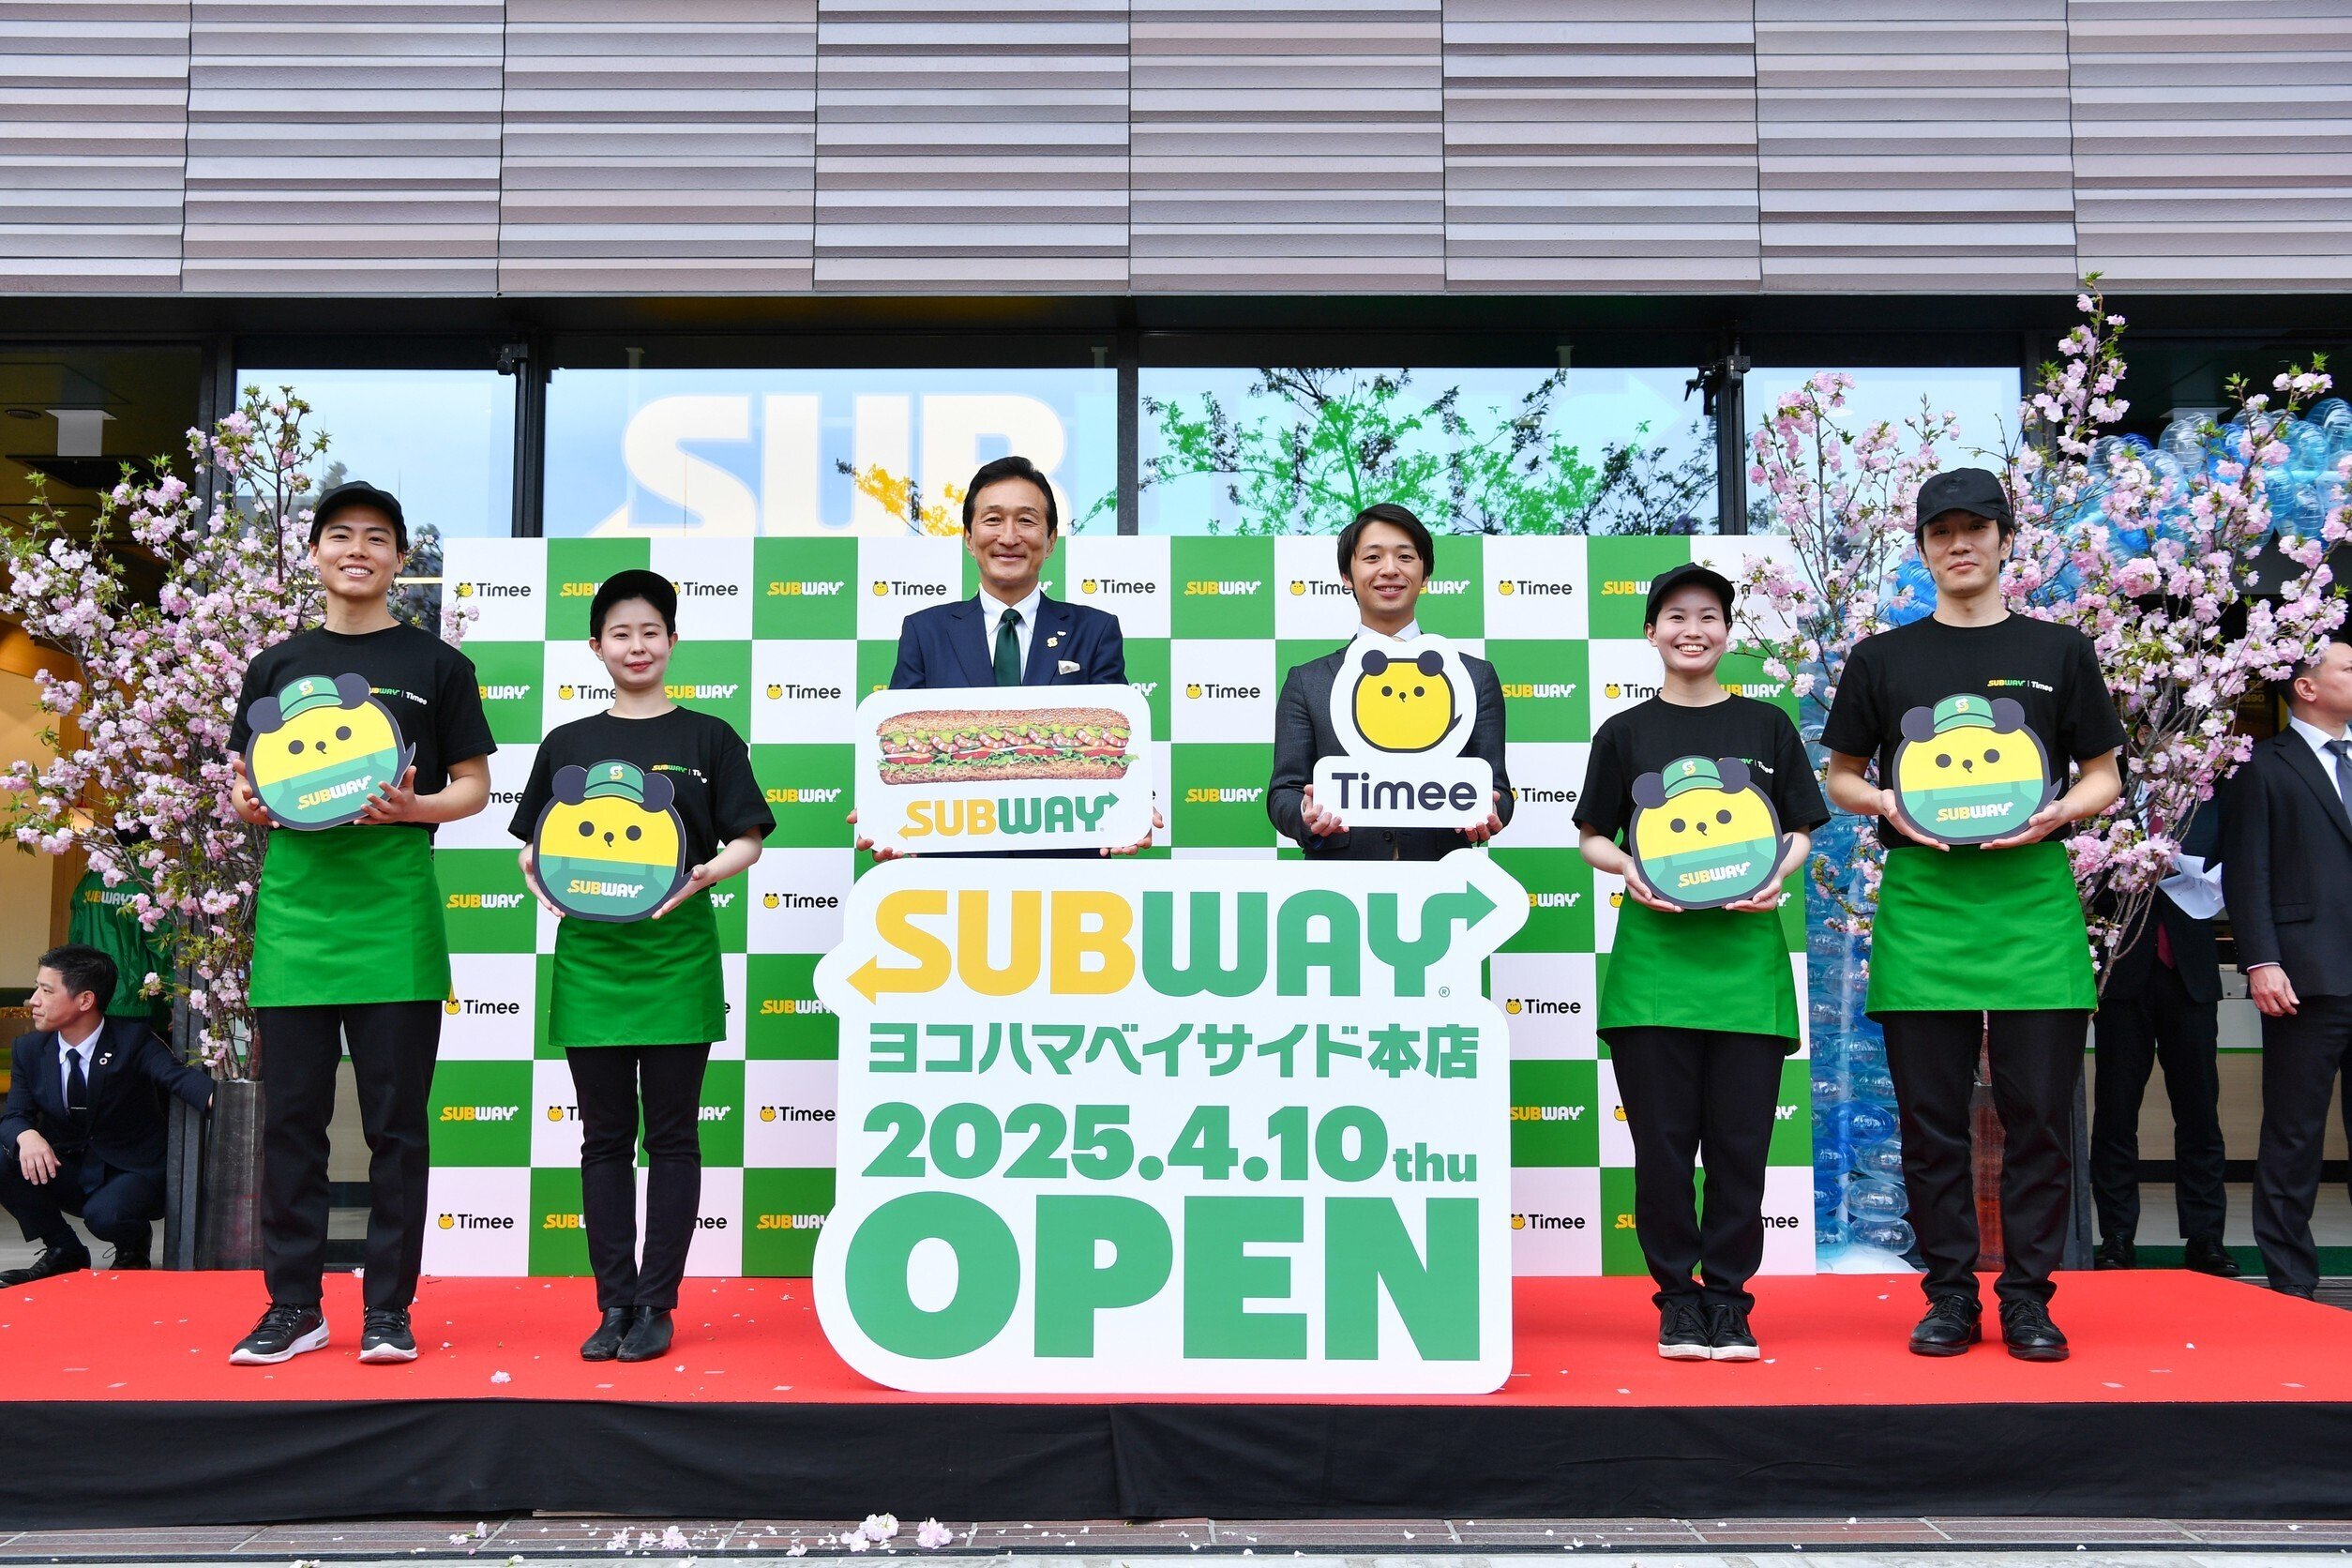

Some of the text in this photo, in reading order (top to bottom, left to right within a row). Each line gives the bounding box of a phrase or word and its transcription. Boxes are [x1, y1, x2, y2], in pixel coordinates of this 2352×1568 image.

[476, 583, 532, 597] Timee
[559, 582, 603, 597] SUB
[683, 582, 739, 596] Timee
[766, 580, 845, 596] SUBWAY
[891, 580, 947, 596] Timee
[1100, 580, 1156, 595] Timee
[1184, 580, 1262, 595] SUBWAY
[1308, 580, 1353, 595] Time
[1420, 580, 1470, 595] WAY
[1516, 580, 1573, 596] Timee
[1601, 580, 1651, 596] SUBW
[1500, 683, 1576, 698] SUBWAY
[1719, 683, 1786, 698] BWAY
[1987, 679, 2026, 687] SUBWAY
[369, 686, 400, 696] UBWAY
[479, 684, 531, 699] BWAY
[577, 685, 615, 700] Time
[665, 684, 739, 699] SUBWAY
[785, 685, 841, 700] Timee
[1204, 684, 1260, 699] Timee
[1623, 684, 1663, 699] Tim
[297, 775, 373, 811] SUBWAY
[490, 792, 523, 804] mee
[765, 788, 841, 803] SUBWAY
[1184, 787, 1263, 803] SUBWAY
[1332, 772, 1478, 811] Timee
[1521, 787, 1577, 803] Timee
[897, 791, 1120, 840] SUBWAY
[1936, 801, 2014, 822] SUBWAY
[1677, 861, 1752, 889] SUBWAY
[566, 879, 645, 898] SUBWAY
[445, 893, 525, 909] SUBWAY
[782, 893, 838, 909] Timee
[1528, 892, 1581, 908] BWAY
[845, 880, 1499, 1005] SUBWAY
[464, 1000, 520, 1015] Timee
[1525, 999, 1581, 1015] Timee
[868, 1022, 1480, 1079] ヨコハマベイサイド本店
[439, 1105, 519, 1122] SUBWAY
[779, 1107, 836, 1122] Timee
[1510, 1105, 1586, 1121] SUBWAY
[458, 1214, 514, 1229] Timee
[543, 1214, 585, 1229] SUB
[756, 1214, 827, 1230] SUBWA
[1528, 1214, 1585, 1229] Timee
[1762, 1216, 1799, 1229] mee
[844, 1190, 1481, 1362] OPEN
